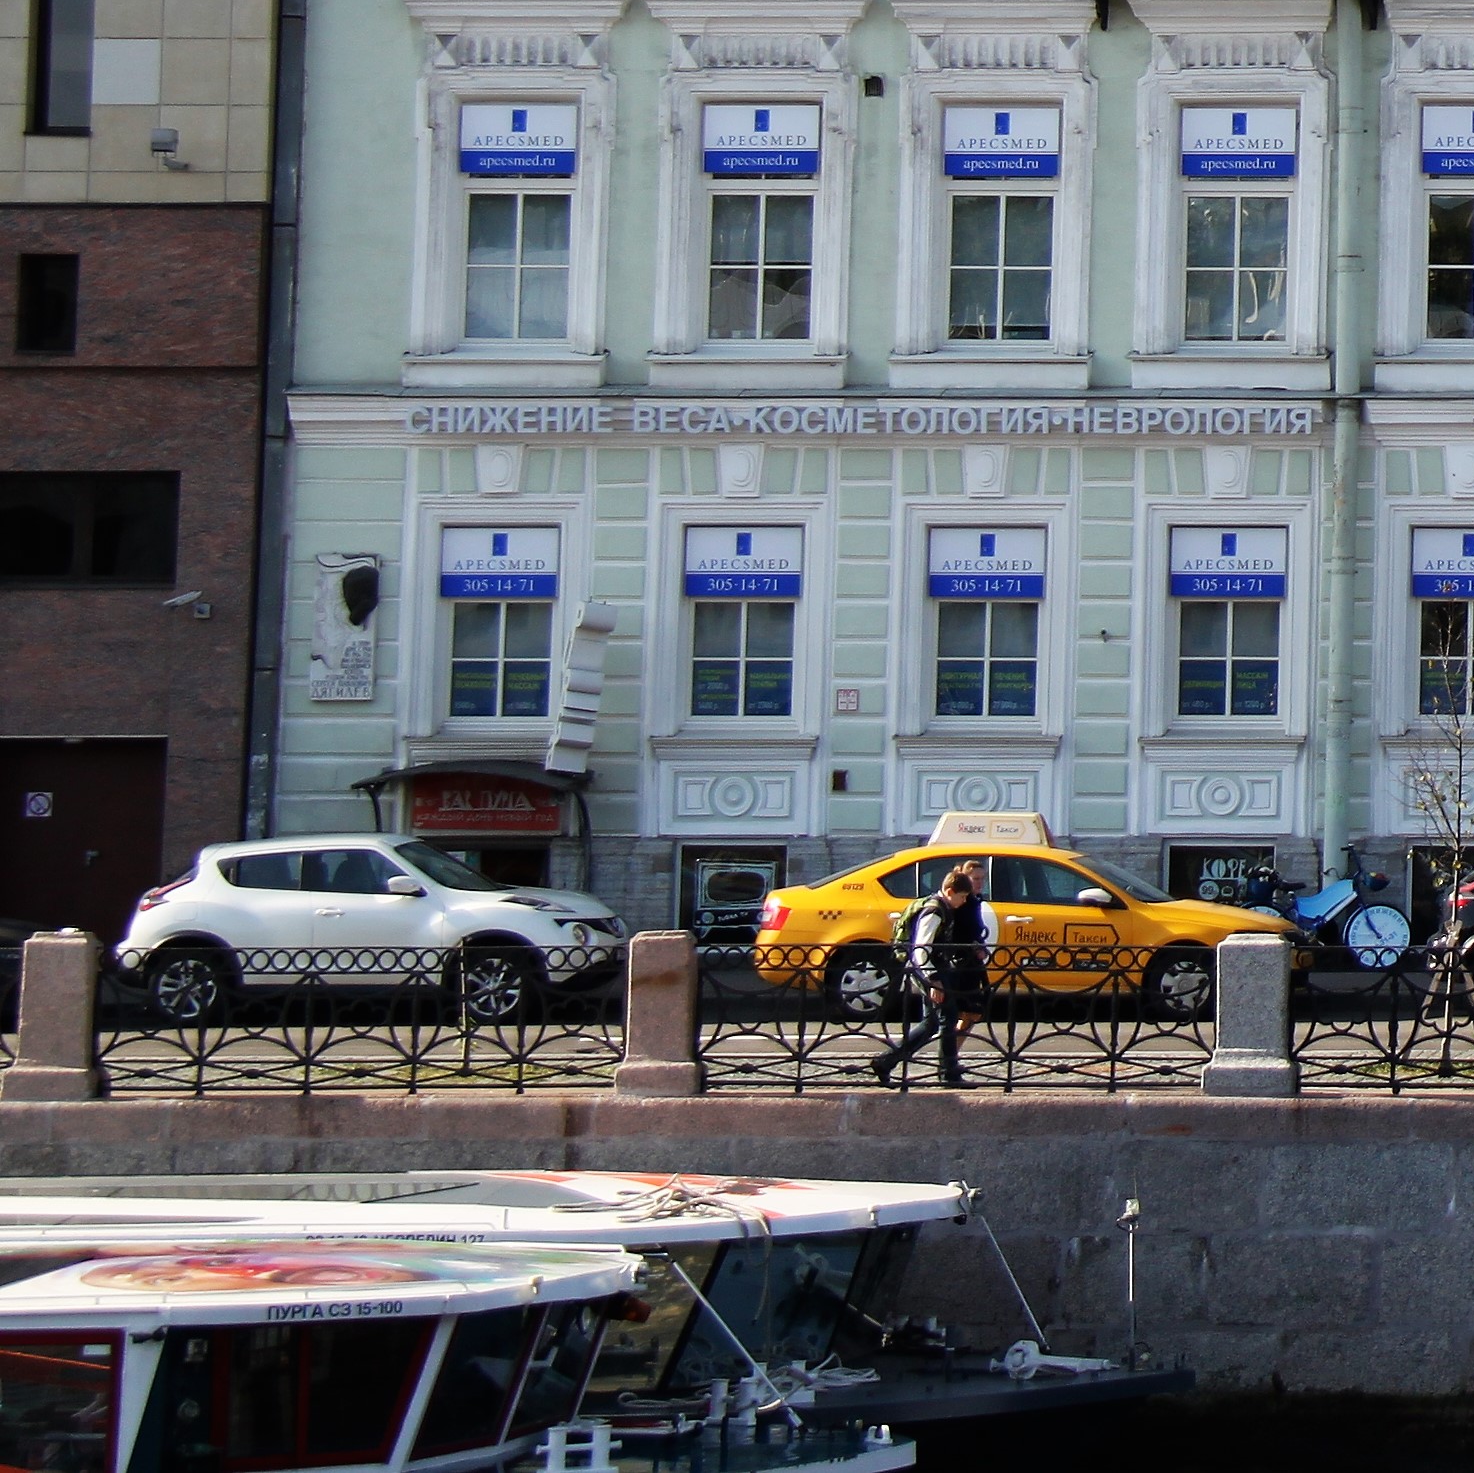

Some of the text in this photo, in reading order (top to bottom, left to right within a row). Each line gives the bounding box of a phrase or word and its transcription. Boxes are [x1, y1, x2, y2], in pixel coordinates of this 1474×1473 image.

[473, 135, 564, 146] APECSMED
[717, 135, 807, 146] APECSMED
[957, 138, 1047, 149] APECSMED
[1194, 138, 1284, 149] APECSMED
[480, 155, 555, 169] apecsmed.ru
[723, 155, 798, 169] apecsmed.ru
[963, 157, 1038, 172] apecsmed.ru
[1200, 157, 1276, 172] apecsmed.ru
[405, 405, 613, 434] СНИЖЕНИЕ
[454, 560, 546, 570] APECSMED
[698, 560, 789, 571] APECSMED
[942, 560, 1033, 571] APECSMED
[1183, 560, 1273, 571] APECSMED
[958, 822, 1018, 834] Яндекс Такси
[1015, 926, 1107, 943] Яндекс Такси
[268, 1303, 324, 1321] ПУРГА
[356, 1300, 403, 1316] 15-100
